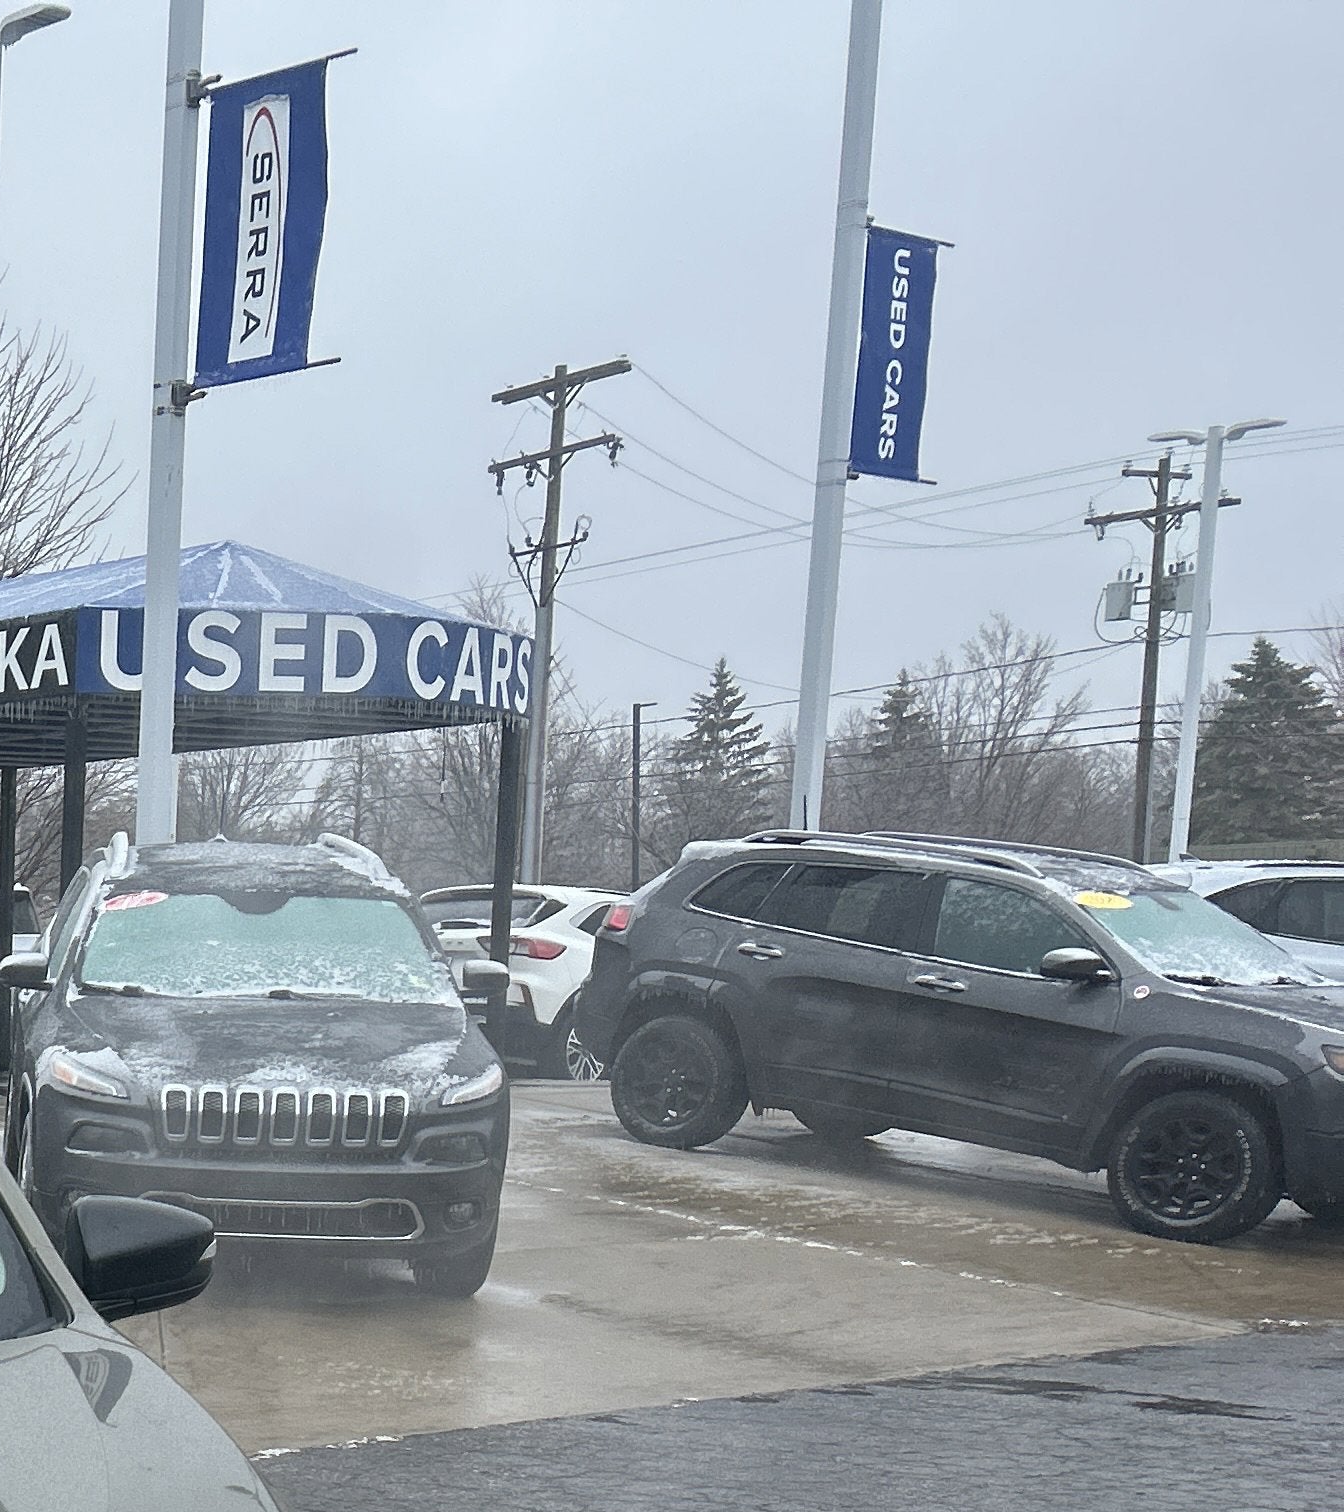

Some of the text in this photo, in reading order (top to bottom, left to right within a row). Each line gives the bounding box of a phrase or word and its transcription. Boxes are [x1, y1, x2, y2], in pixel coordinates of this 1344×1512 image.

[240, 151, 272, 344] SERRA
[877, 247, 911, 461] USED CARS
[100, 609, 532, 714] USED CARS
